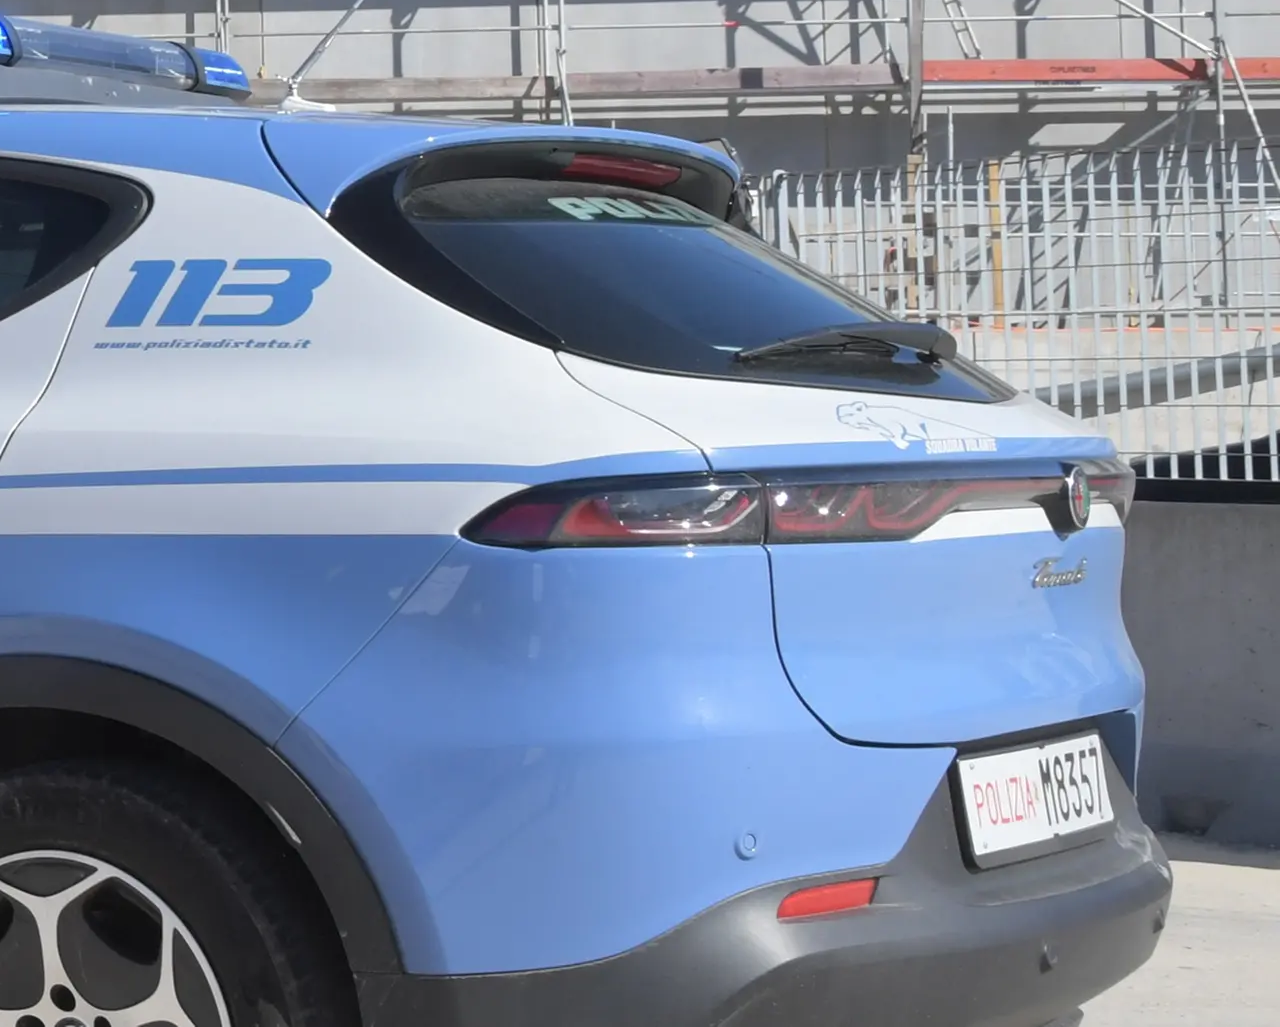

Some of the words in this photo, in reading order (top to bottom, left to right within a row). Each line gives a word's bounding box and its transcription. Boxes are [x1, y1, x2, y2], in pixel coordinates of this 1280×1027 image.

[105, 258, 332, 327] 113
[93, 338, 312, 351] www.poliziadistato.it
[973, 775, 1037, 828] POLIZIA
[1039, 747, 1103, 826] M8357
